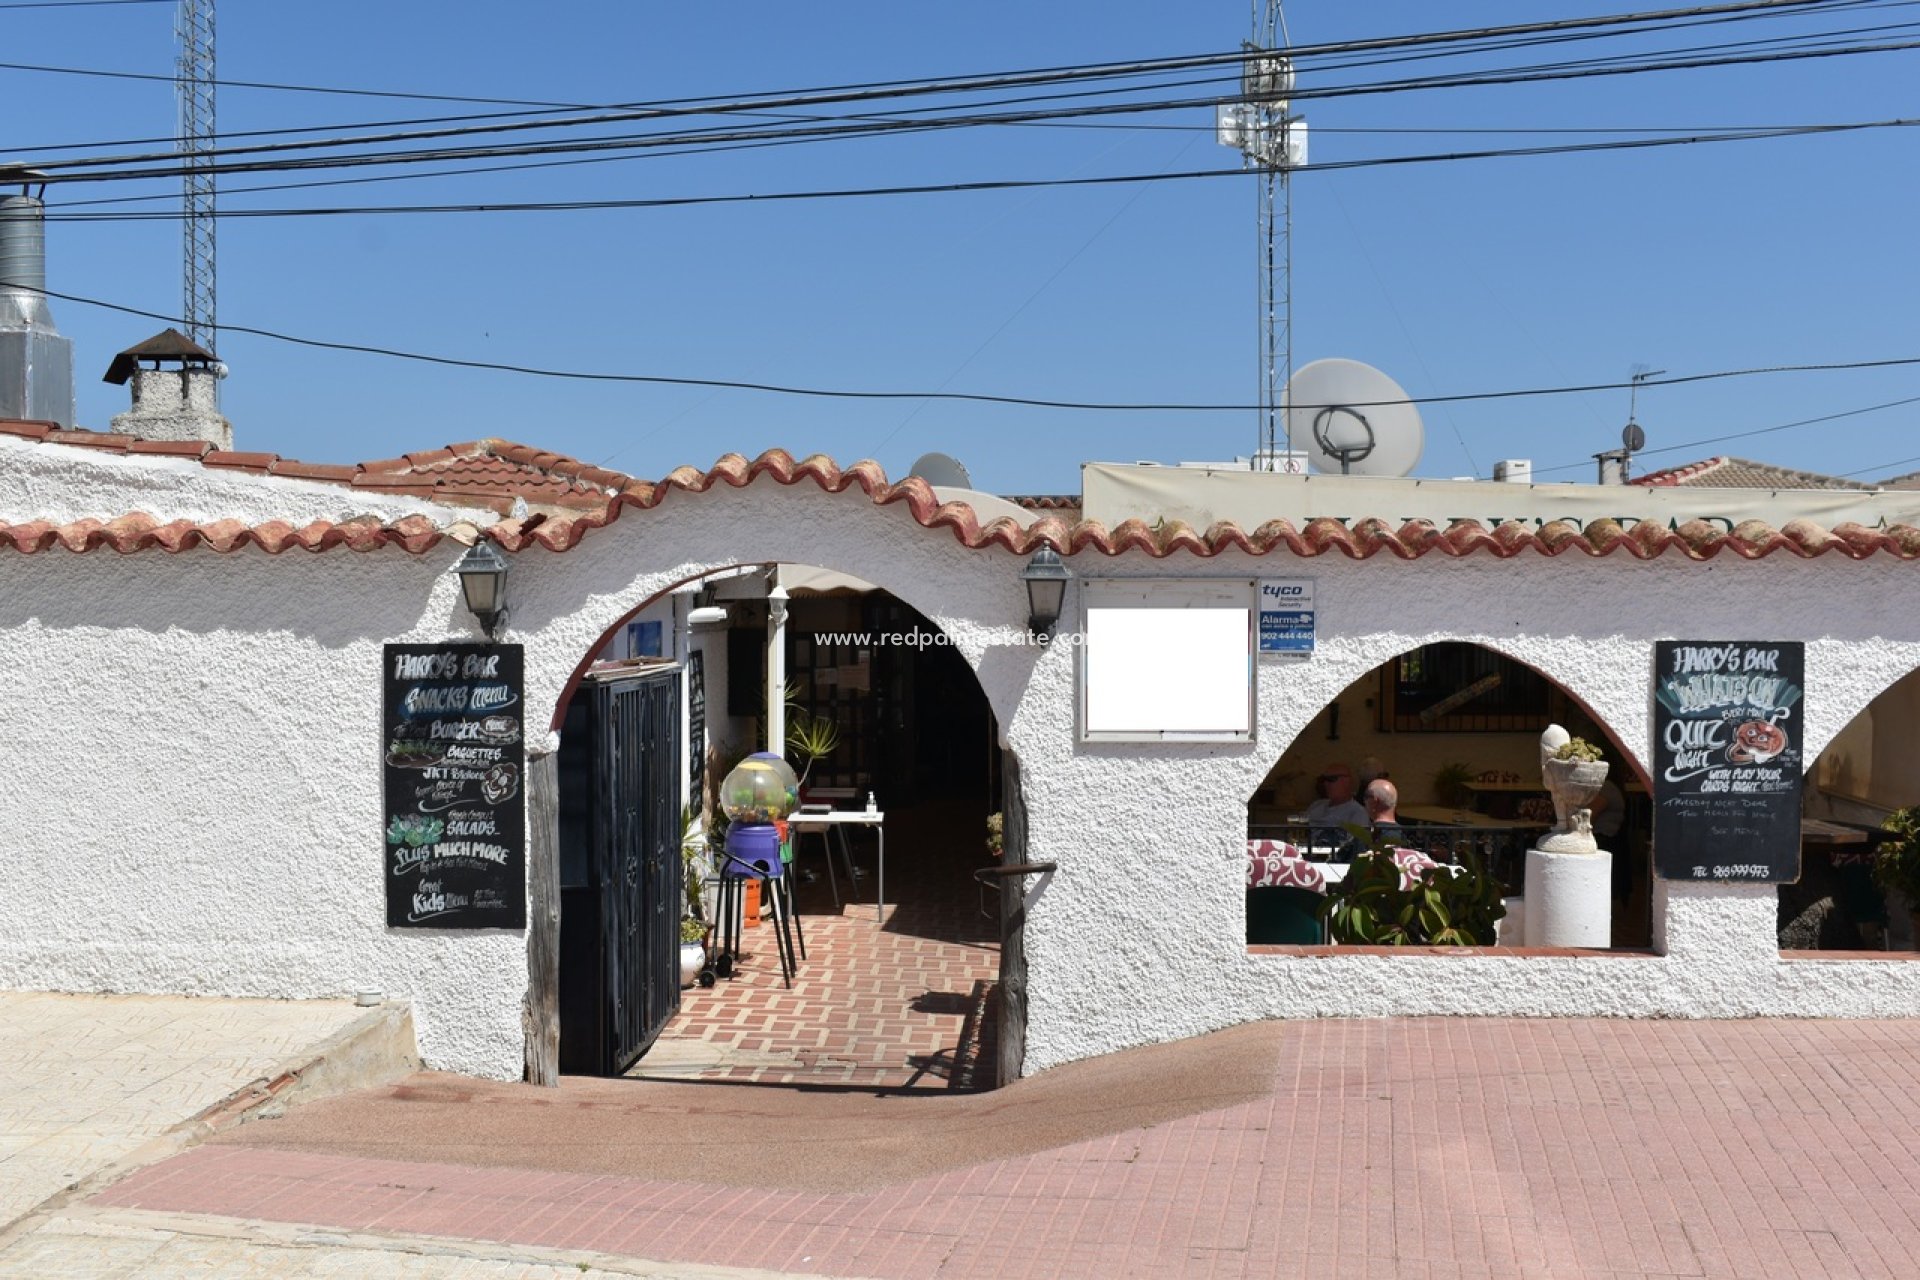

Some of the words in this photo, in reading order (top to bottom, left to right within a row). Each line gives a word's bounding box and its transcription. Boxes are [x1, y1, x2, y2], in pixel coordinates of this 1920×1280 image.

[1262, 584, 1302, 598] tyco
[1261, 614, 1300, 624] Alarma
[1260, 632, 1277, 640] 902
[1278, 632, 1295, 640] 444
[1296, 632, 1313, 640] 440
[1673, 643, 1741, 673] HARRY'S
[1743, 647, 1780, 673] BAR
[405, 685, 469, 714] SNACKS
[1664, 718, 1727, 751] QUIZ
[395, 843, 431, 865] PLUS
[434, 841, 472, 859] MUCH
[472, 841, 511, 866] MORE
[412, 892, 446, 915] Kids
